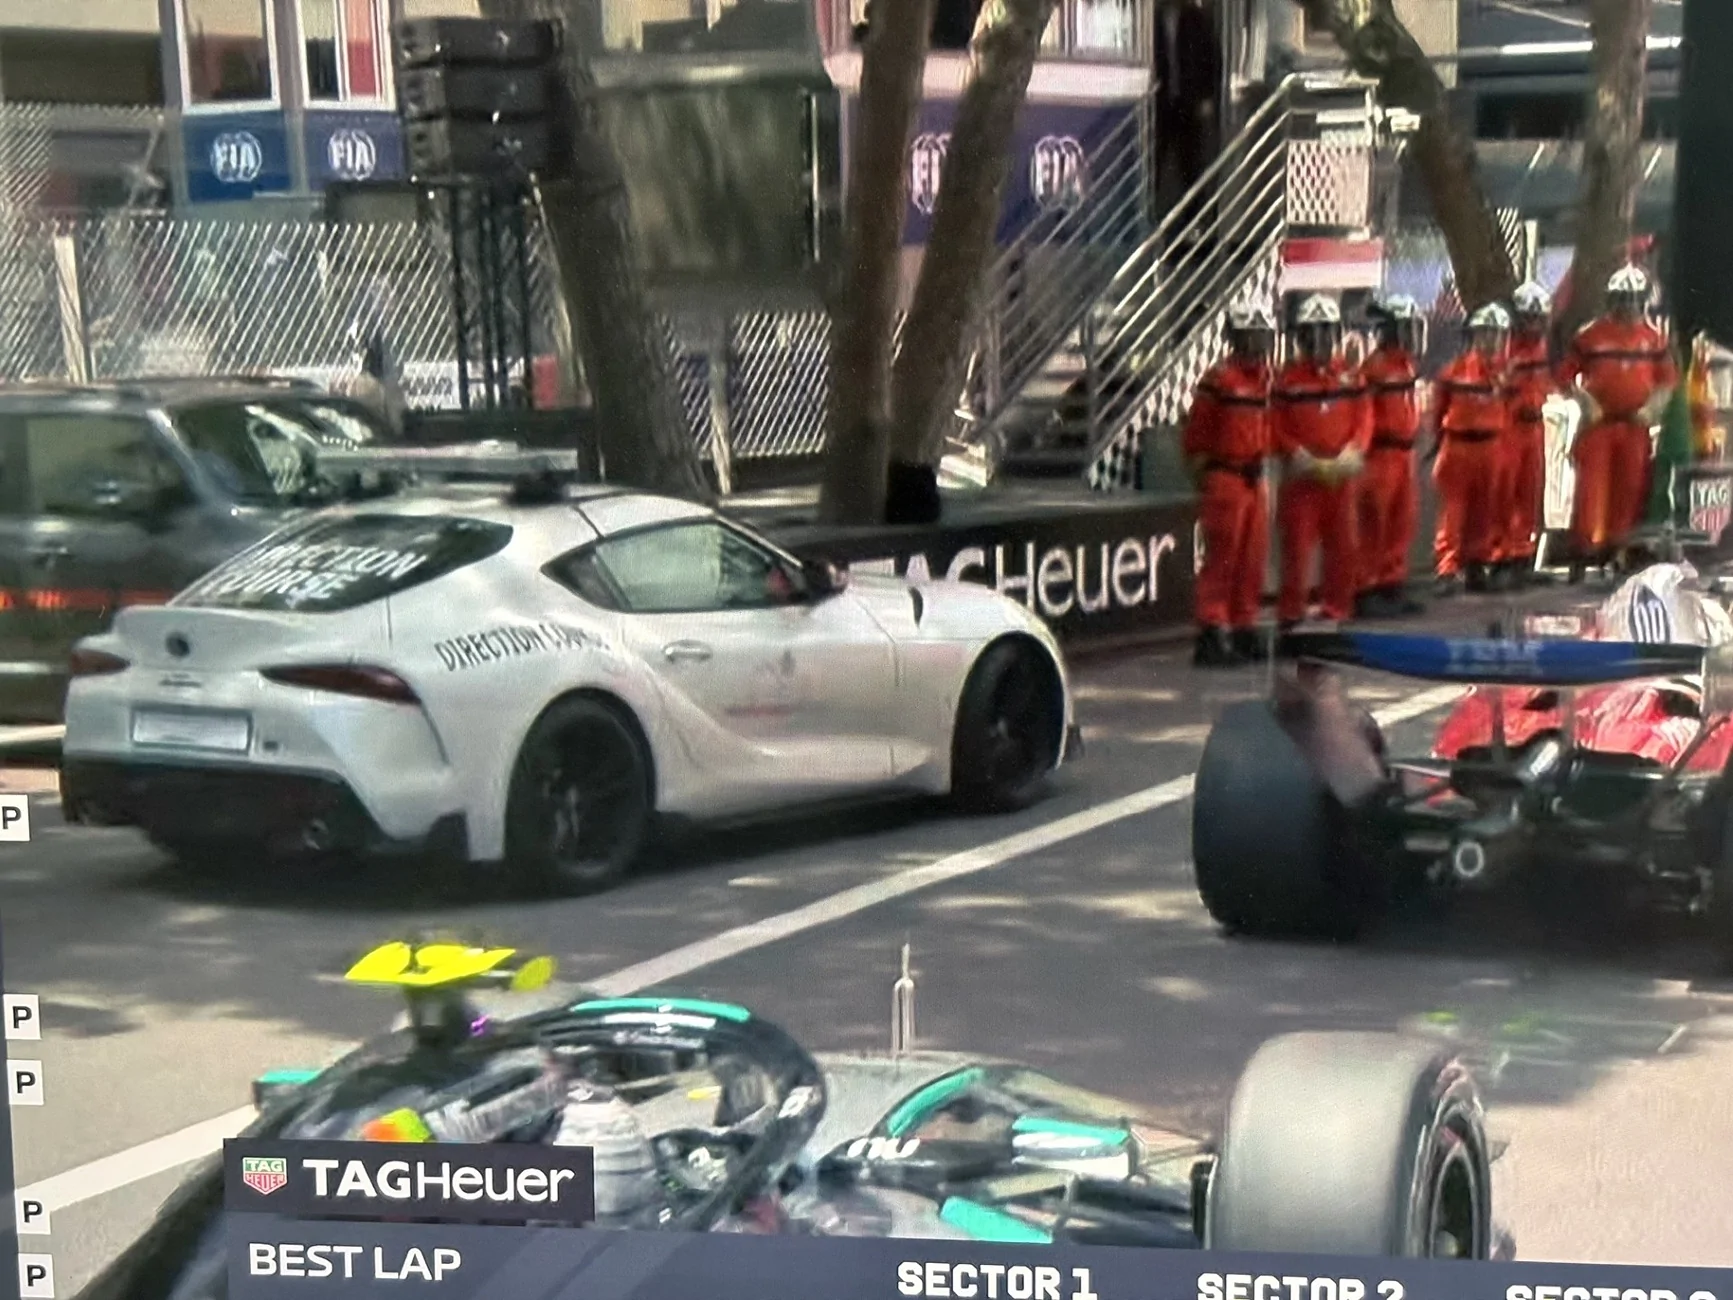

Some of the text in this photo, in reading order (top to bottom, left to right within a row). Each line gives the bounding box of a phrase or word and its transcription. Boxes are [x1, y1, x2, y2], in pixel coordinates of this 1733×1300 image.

[213, 139, 256, 178] FIA
[331, 136, 374, 174] FIA
[849, 532, 1175, 618] Heuer
[433, 624, 548, 671] DIRECTION
[2, 806, 21, 830] P
[12, 1006, 32, 1029] P
[16, 1071, 36, 1094] P
[246, 1160, 283, 1173] TAG
[246, 1173, 284, 1191] HEUER
[23, 1200, 43, 1223] P
[249, 1242, 461, 1281] BEST LAP
[27, 1264, 47, 1287] P
[898, 1261, 1098, 1300] SECTOR 1
[1197, 1273, 1365, 1300] SECTOR
